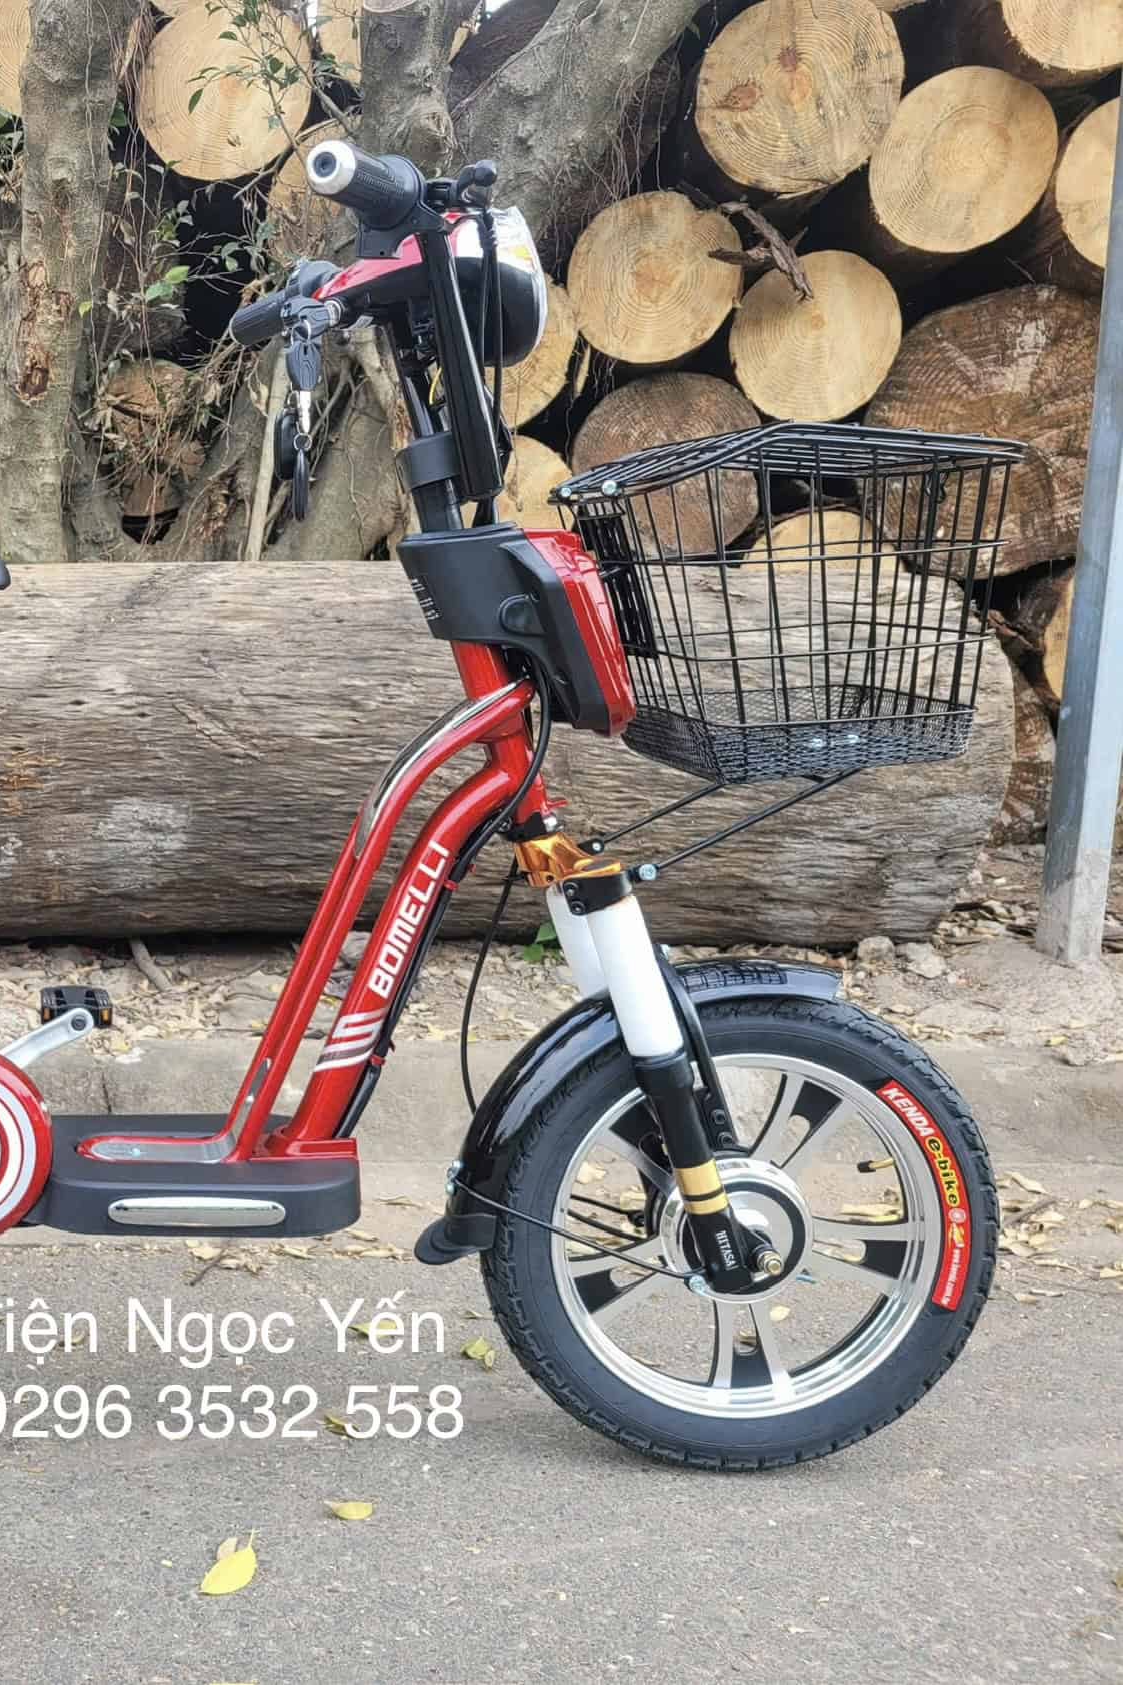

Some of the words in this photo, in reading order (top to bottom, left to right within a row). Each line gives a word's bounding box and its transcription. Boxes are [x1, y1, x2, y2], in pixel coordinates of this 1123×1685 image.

[367, 840, 450, 999] BOMELLI
[883, 1087, 935, 1137] KENDA
[925, 1136, 960, 1207] e-bike
